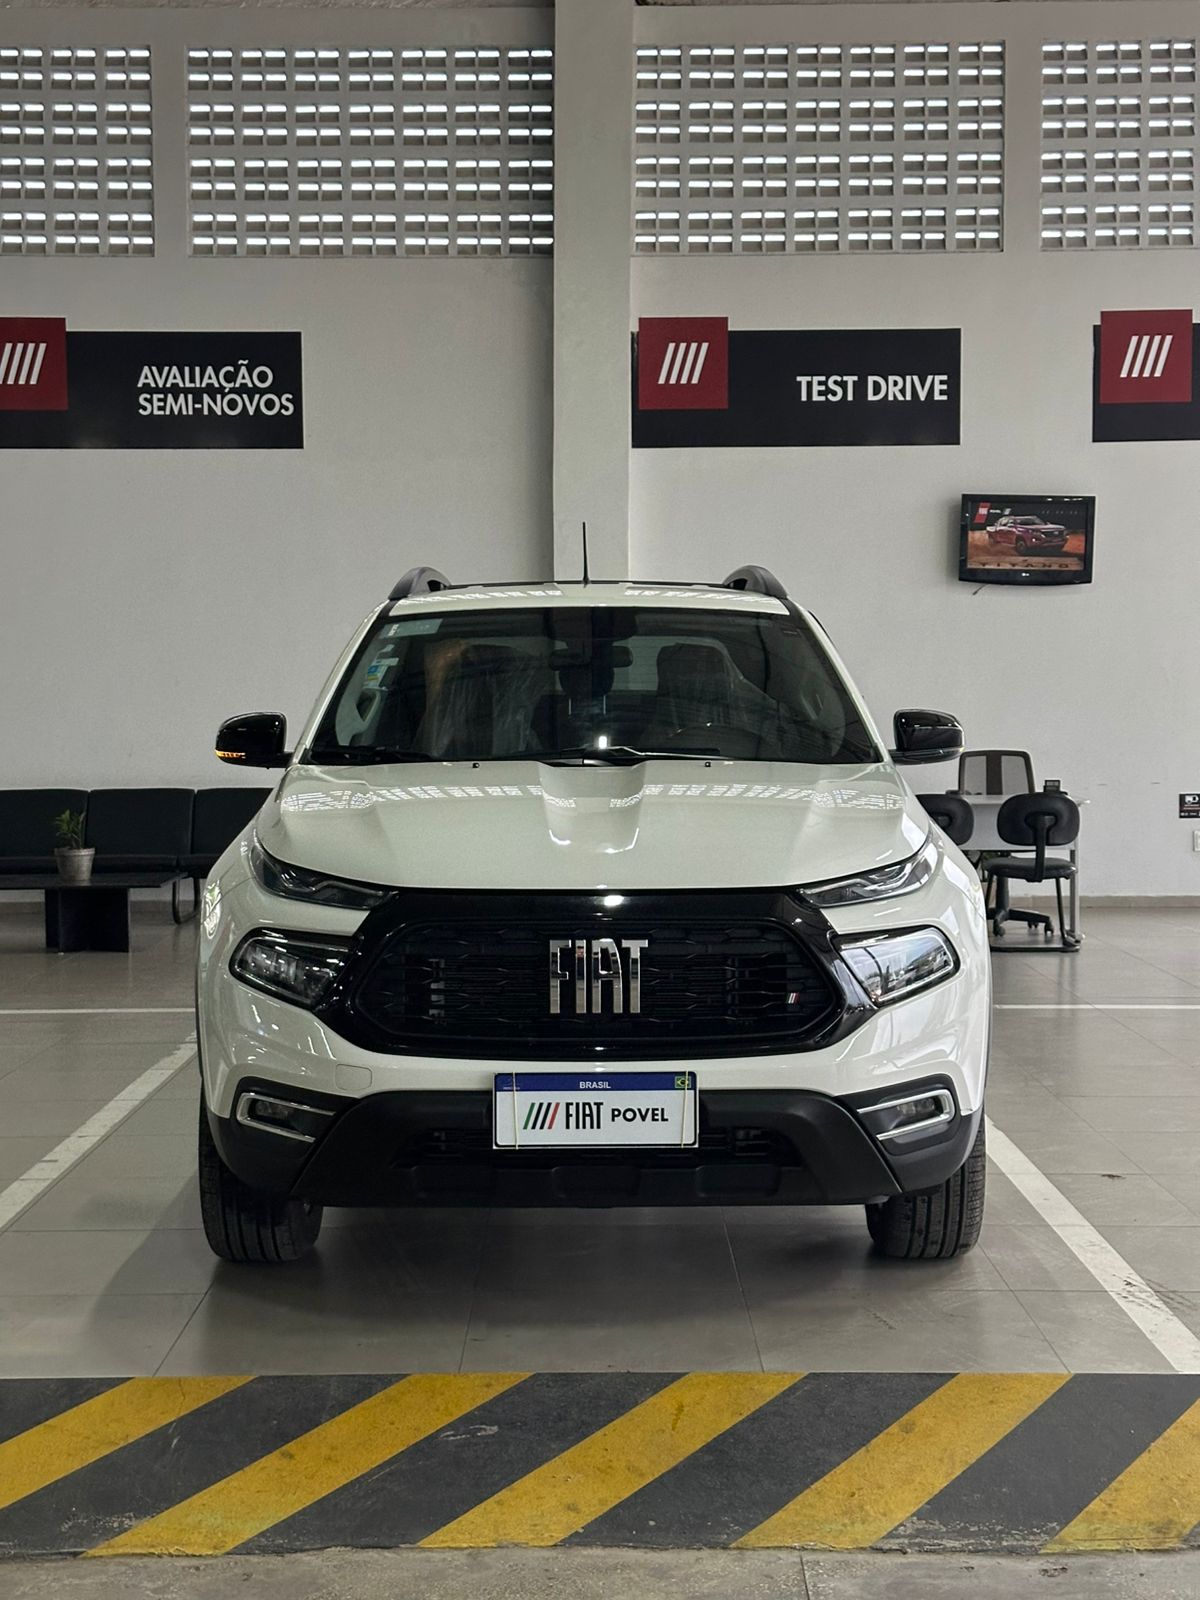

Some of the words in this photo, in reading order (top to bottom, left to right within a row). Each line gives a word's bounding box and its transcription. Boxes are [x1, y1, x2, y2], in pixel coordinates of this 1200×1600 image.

[136, 359, 273, 392] AVALIAÇÃO
[796, 375, 859, 402] TEST
[867, 374, 949, 402] DRIVE
[138, 393, 294, 416] SEMI-NOVOS
[549, 937, 649, 1014] FIAT
[579, 1081, 612, 1089] BRASIL
[565, 1102, 604, 1130] FIAT
[611, 1107, 669, 1122] POVEL
